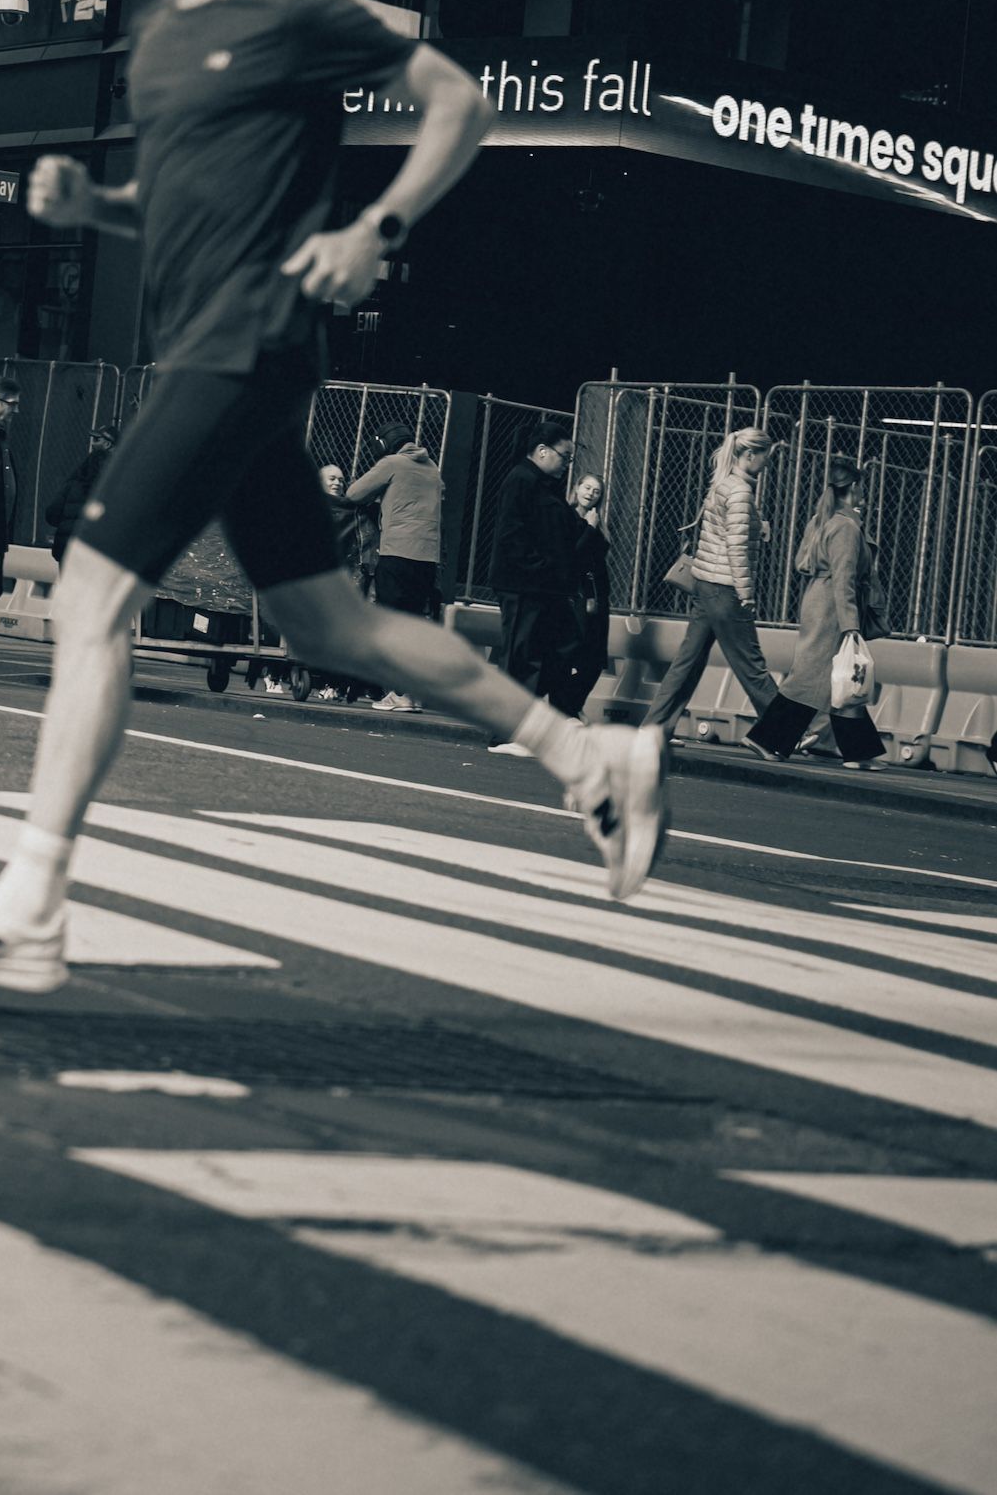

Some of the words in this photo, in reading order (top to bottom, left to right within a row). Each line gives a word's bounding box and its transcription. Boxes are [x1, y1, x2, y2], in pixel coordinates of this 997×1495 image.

[479, 59, 564, 113] this
[583, 58, 652, 116] fall
[712, 94, 793, 149] one
[800, 104, 916, 175] times
[921, 141, 997, 205] squ
[357, 311, 381, 333] EXIT
